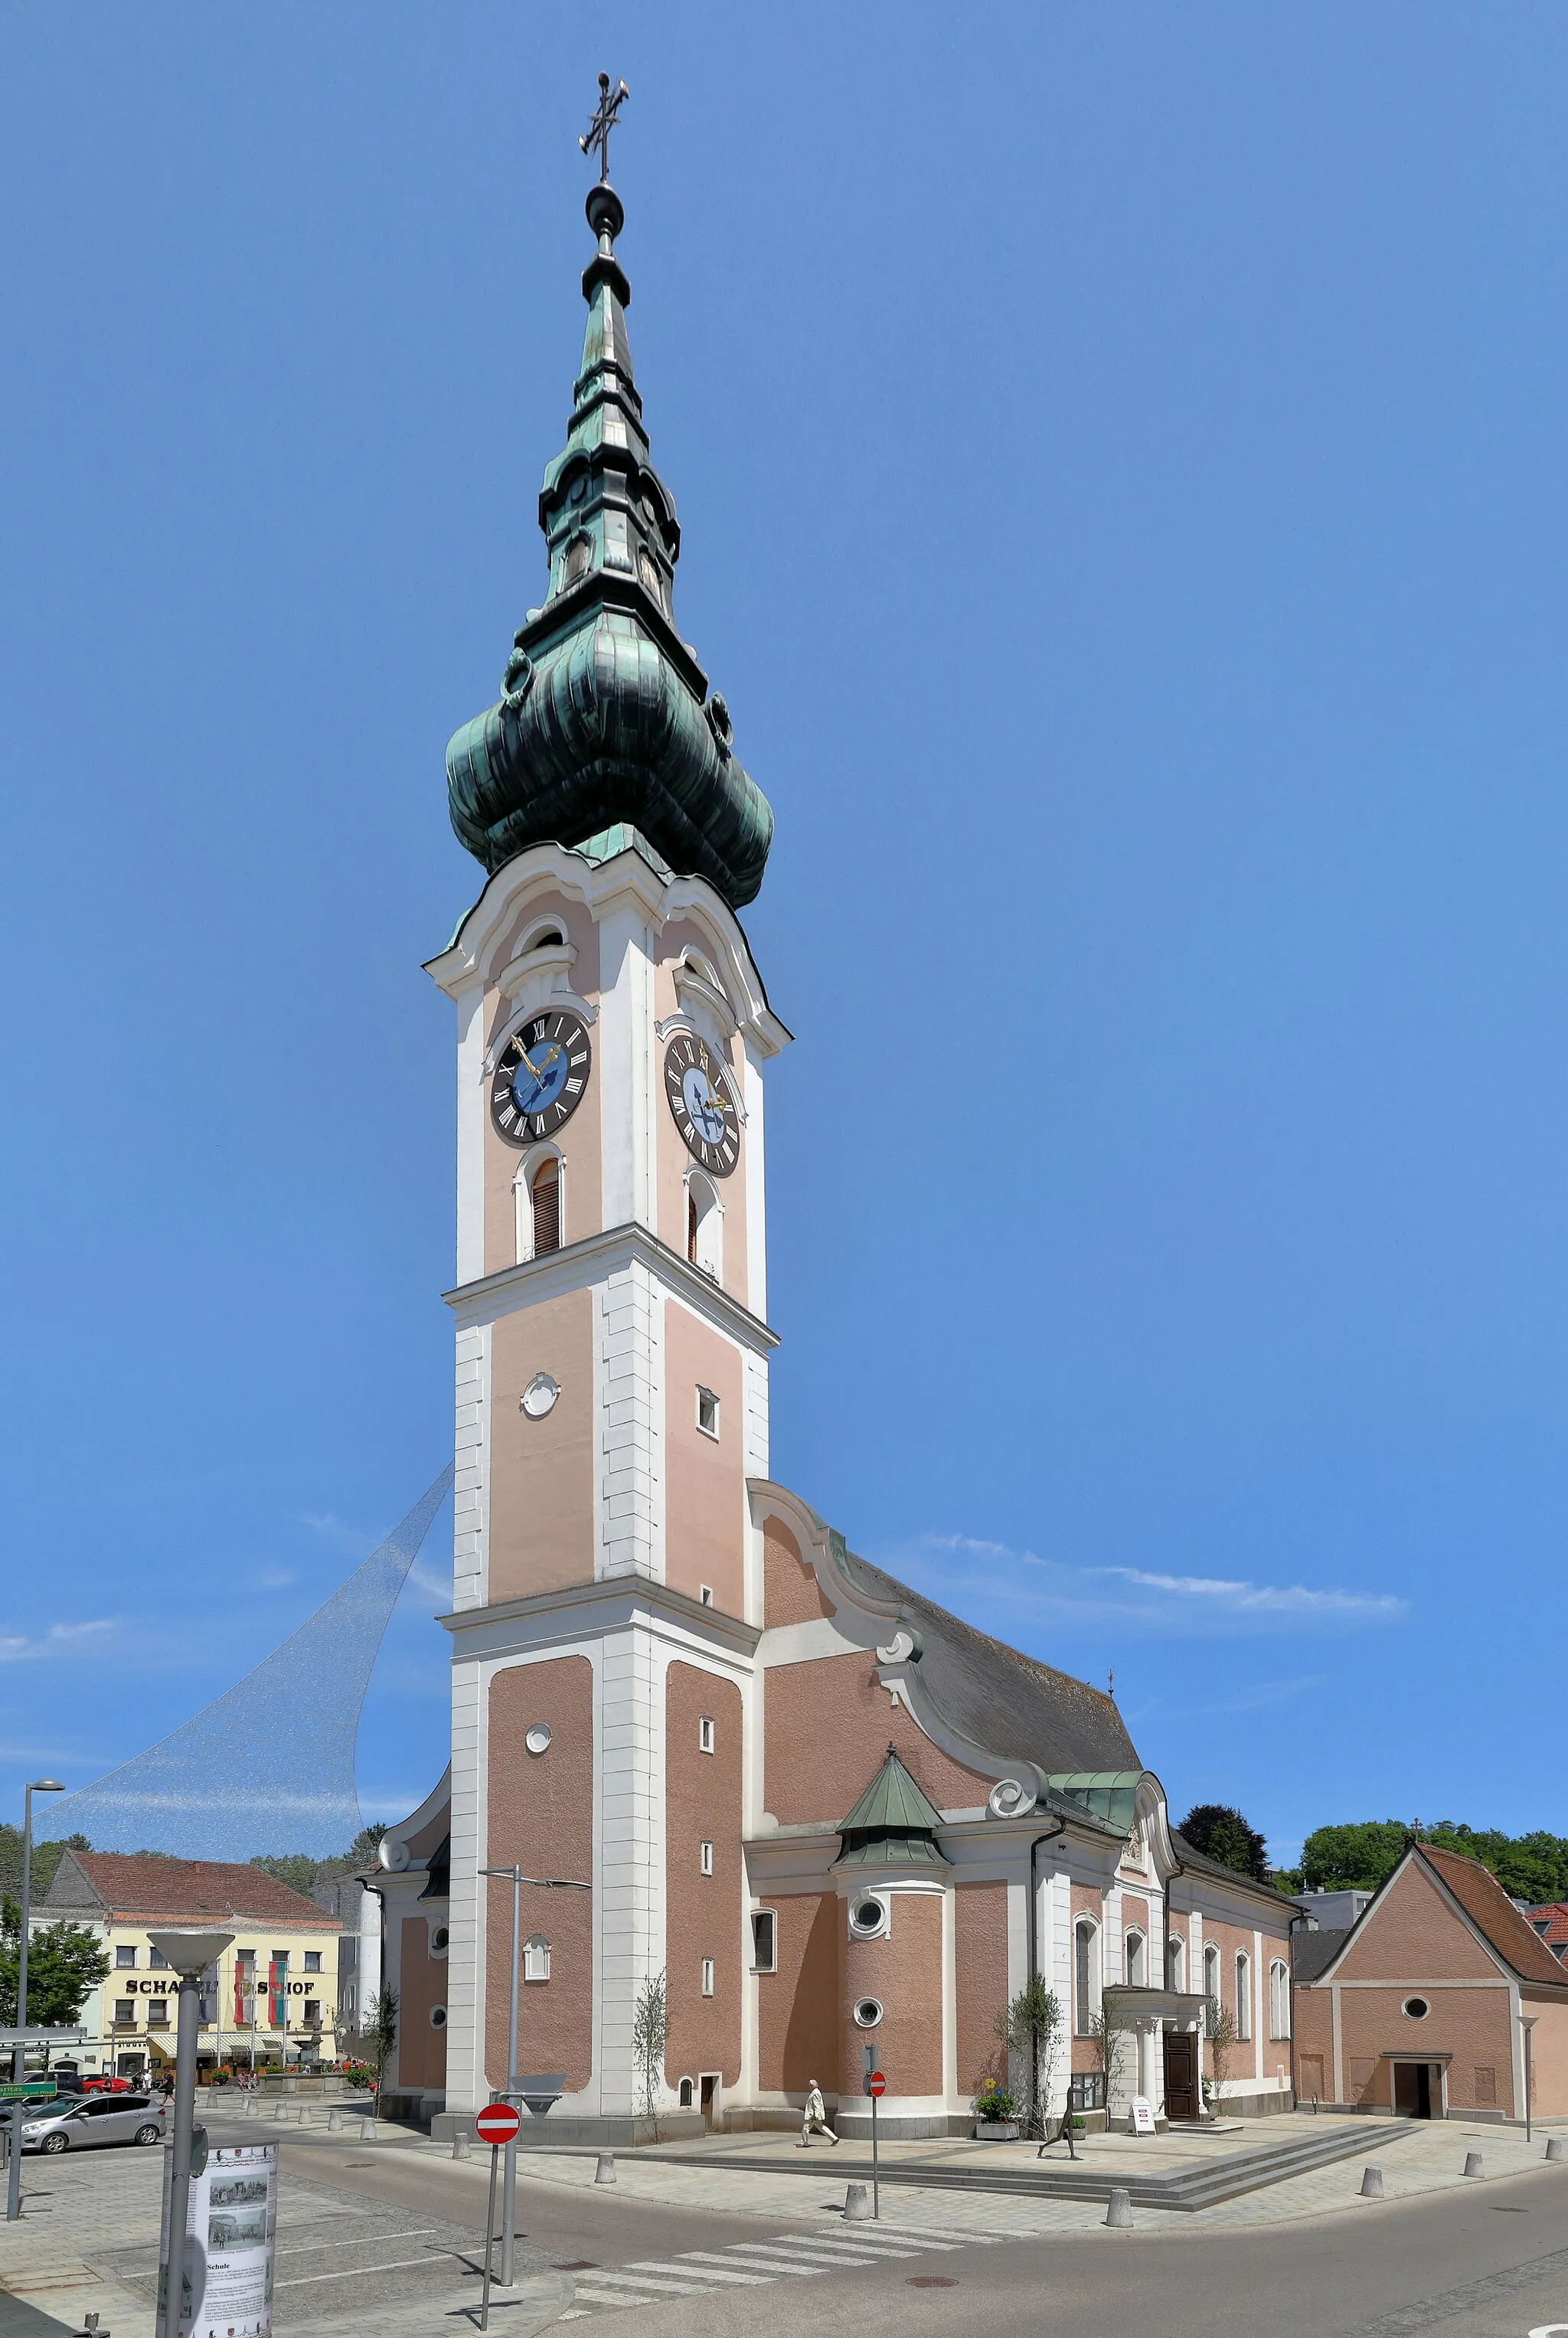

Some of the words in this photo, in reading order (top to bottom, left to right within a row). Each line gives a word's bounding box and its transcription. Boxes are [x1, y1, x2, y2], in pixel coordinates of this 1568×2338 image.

[533, 1019, 545, 1042] XII
[565, 1028, 581, 1048] II
[570, 1050, 587, 1067] III
[671, 1045, 685, 1070] X
[498, 1064, 515, 1076] X
[494, 1087, 510, 1103] IX
[498, 1104, 517, 1128] VIII
[554, 1101, 567, 1119] V
[535, 1114, 546, 1134] VI
